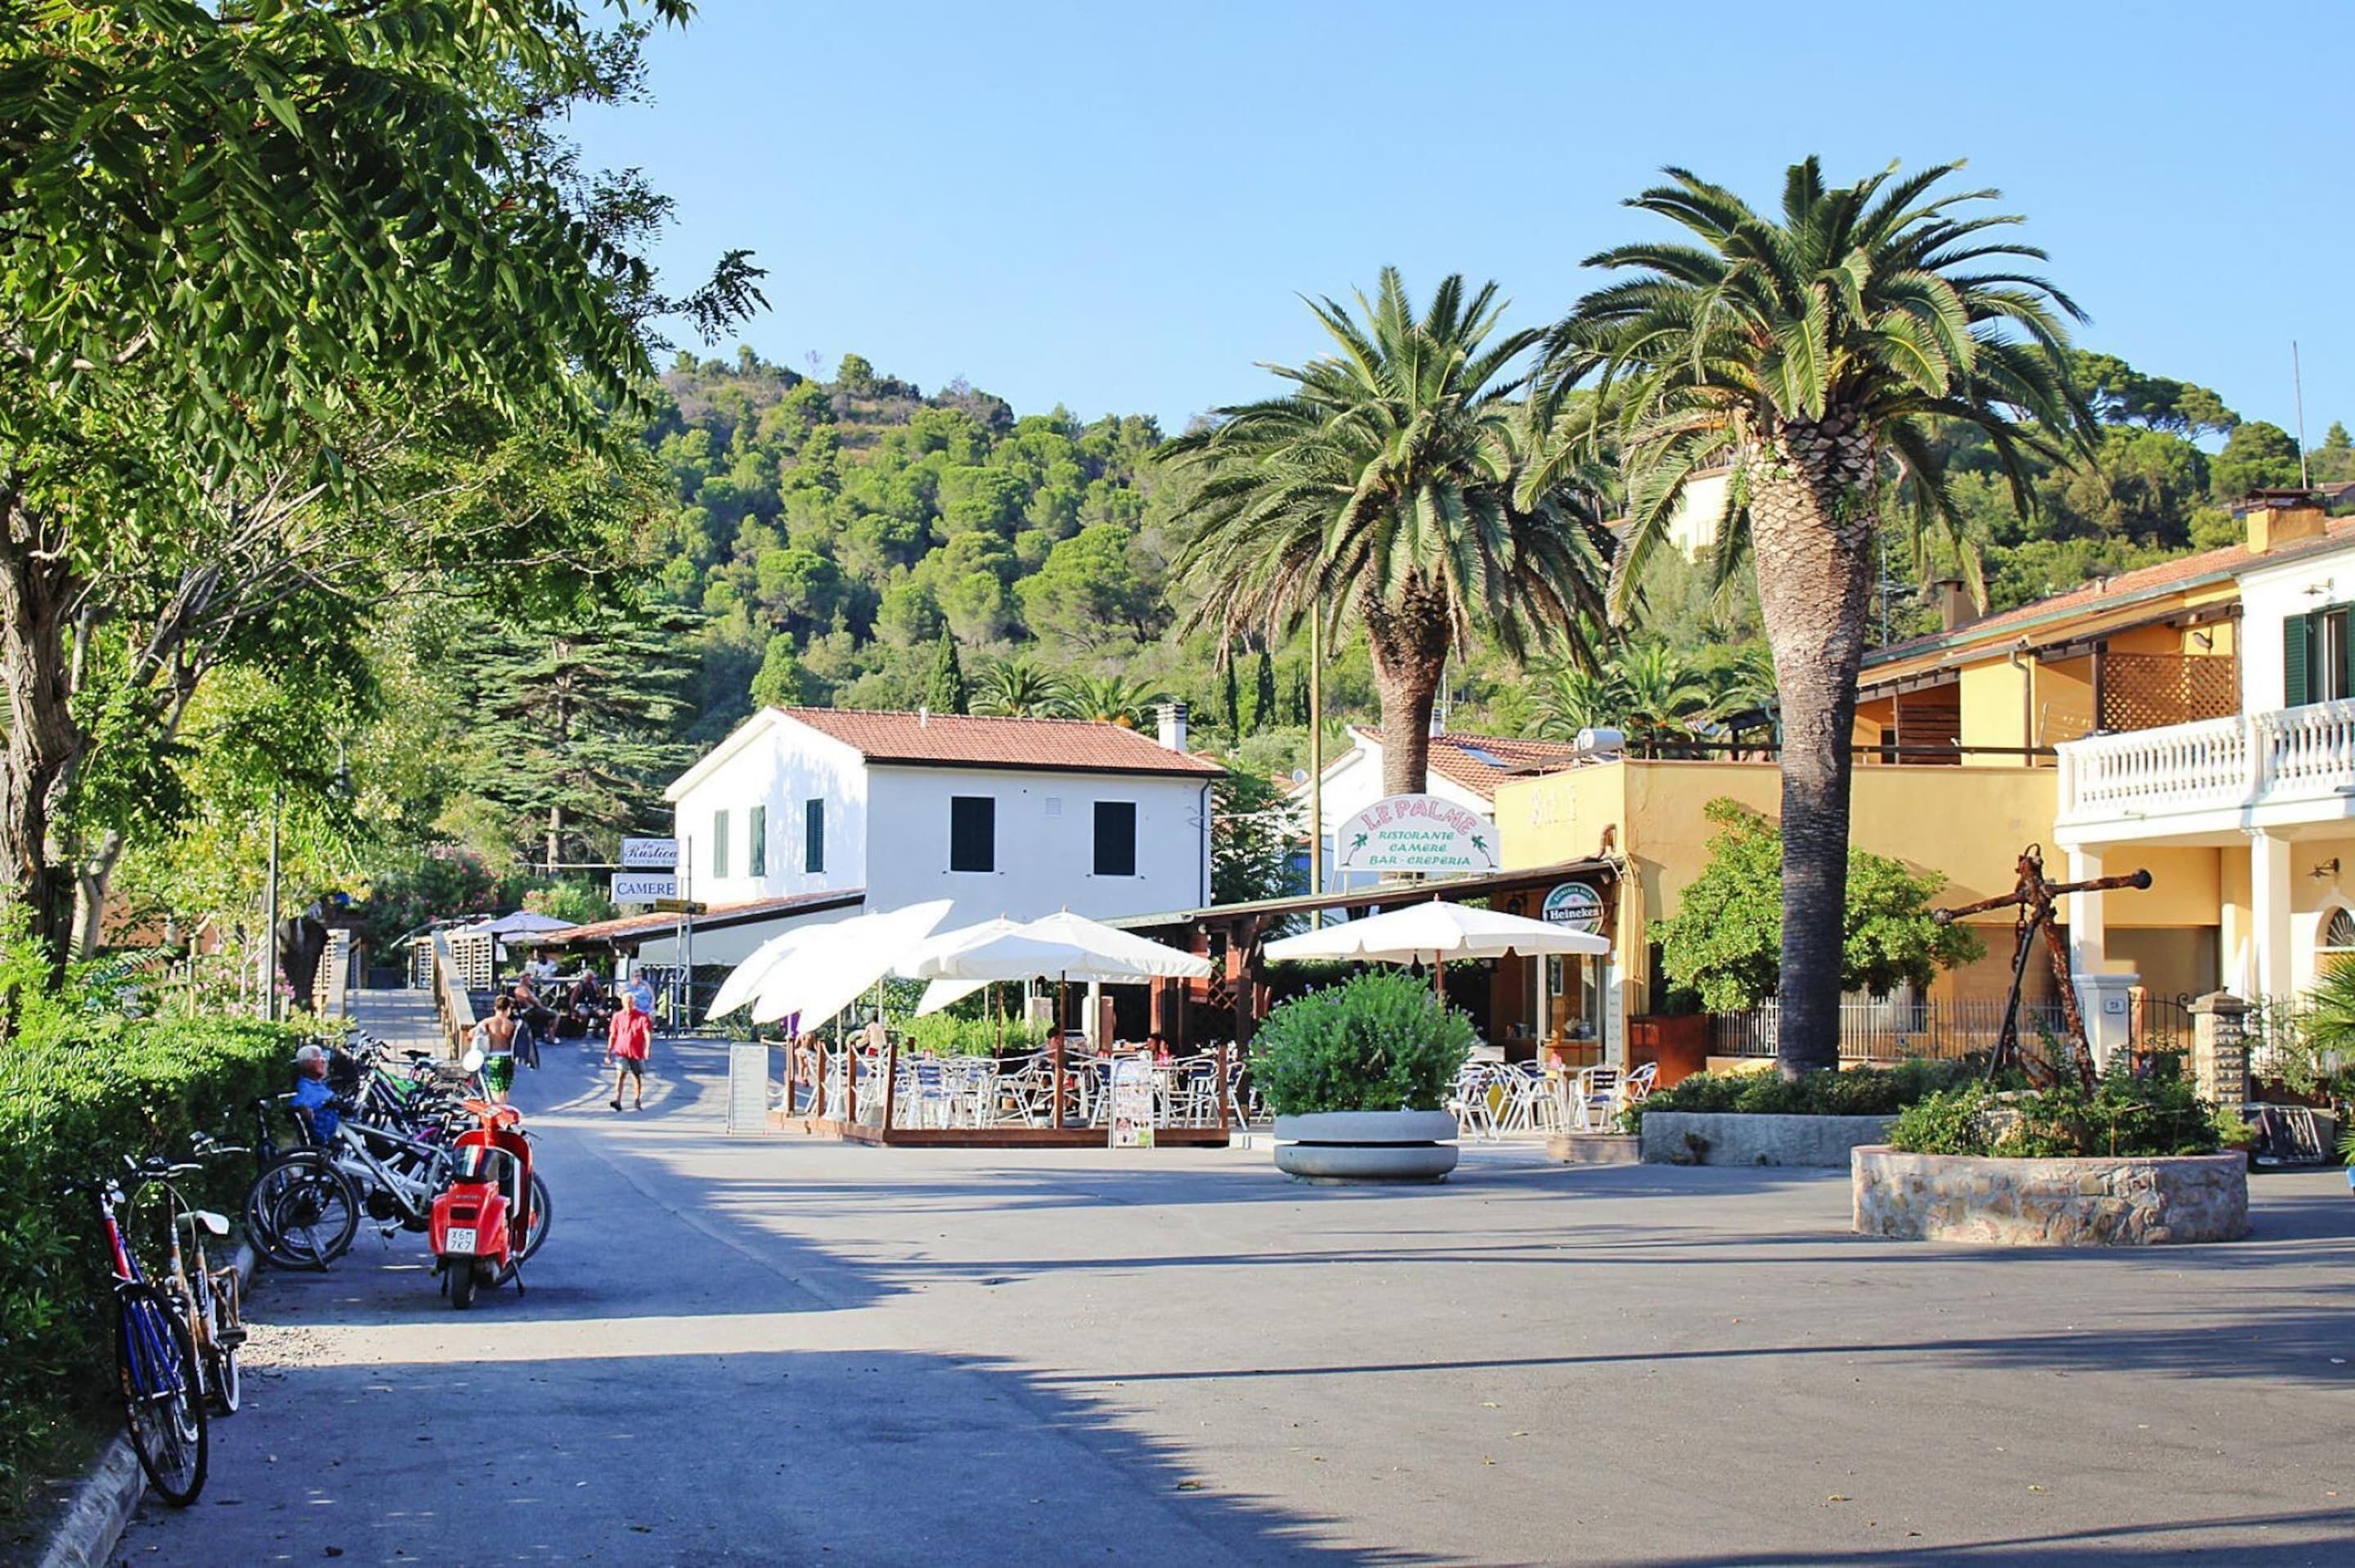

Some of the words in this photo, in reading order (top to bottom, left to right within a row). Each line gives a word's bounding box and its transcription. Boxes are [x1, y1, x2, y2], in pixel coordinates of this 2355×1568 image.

[1361, 804, 1393, 831] LE
[1395, 799, 1478, 835] PALME
[1379, 831, 1456, 840] RISTORANTE
[625, 844, 678, 858] Rustica
[1389, 843, 1447, 853] CAMERE
[1370, 856, 1397, 866] BAR
[1406, 856, 1471, 866] CREPERIA
[617, 882, 676, 895] CAMERE
[1550, 907, 1599, 920] Heineken
